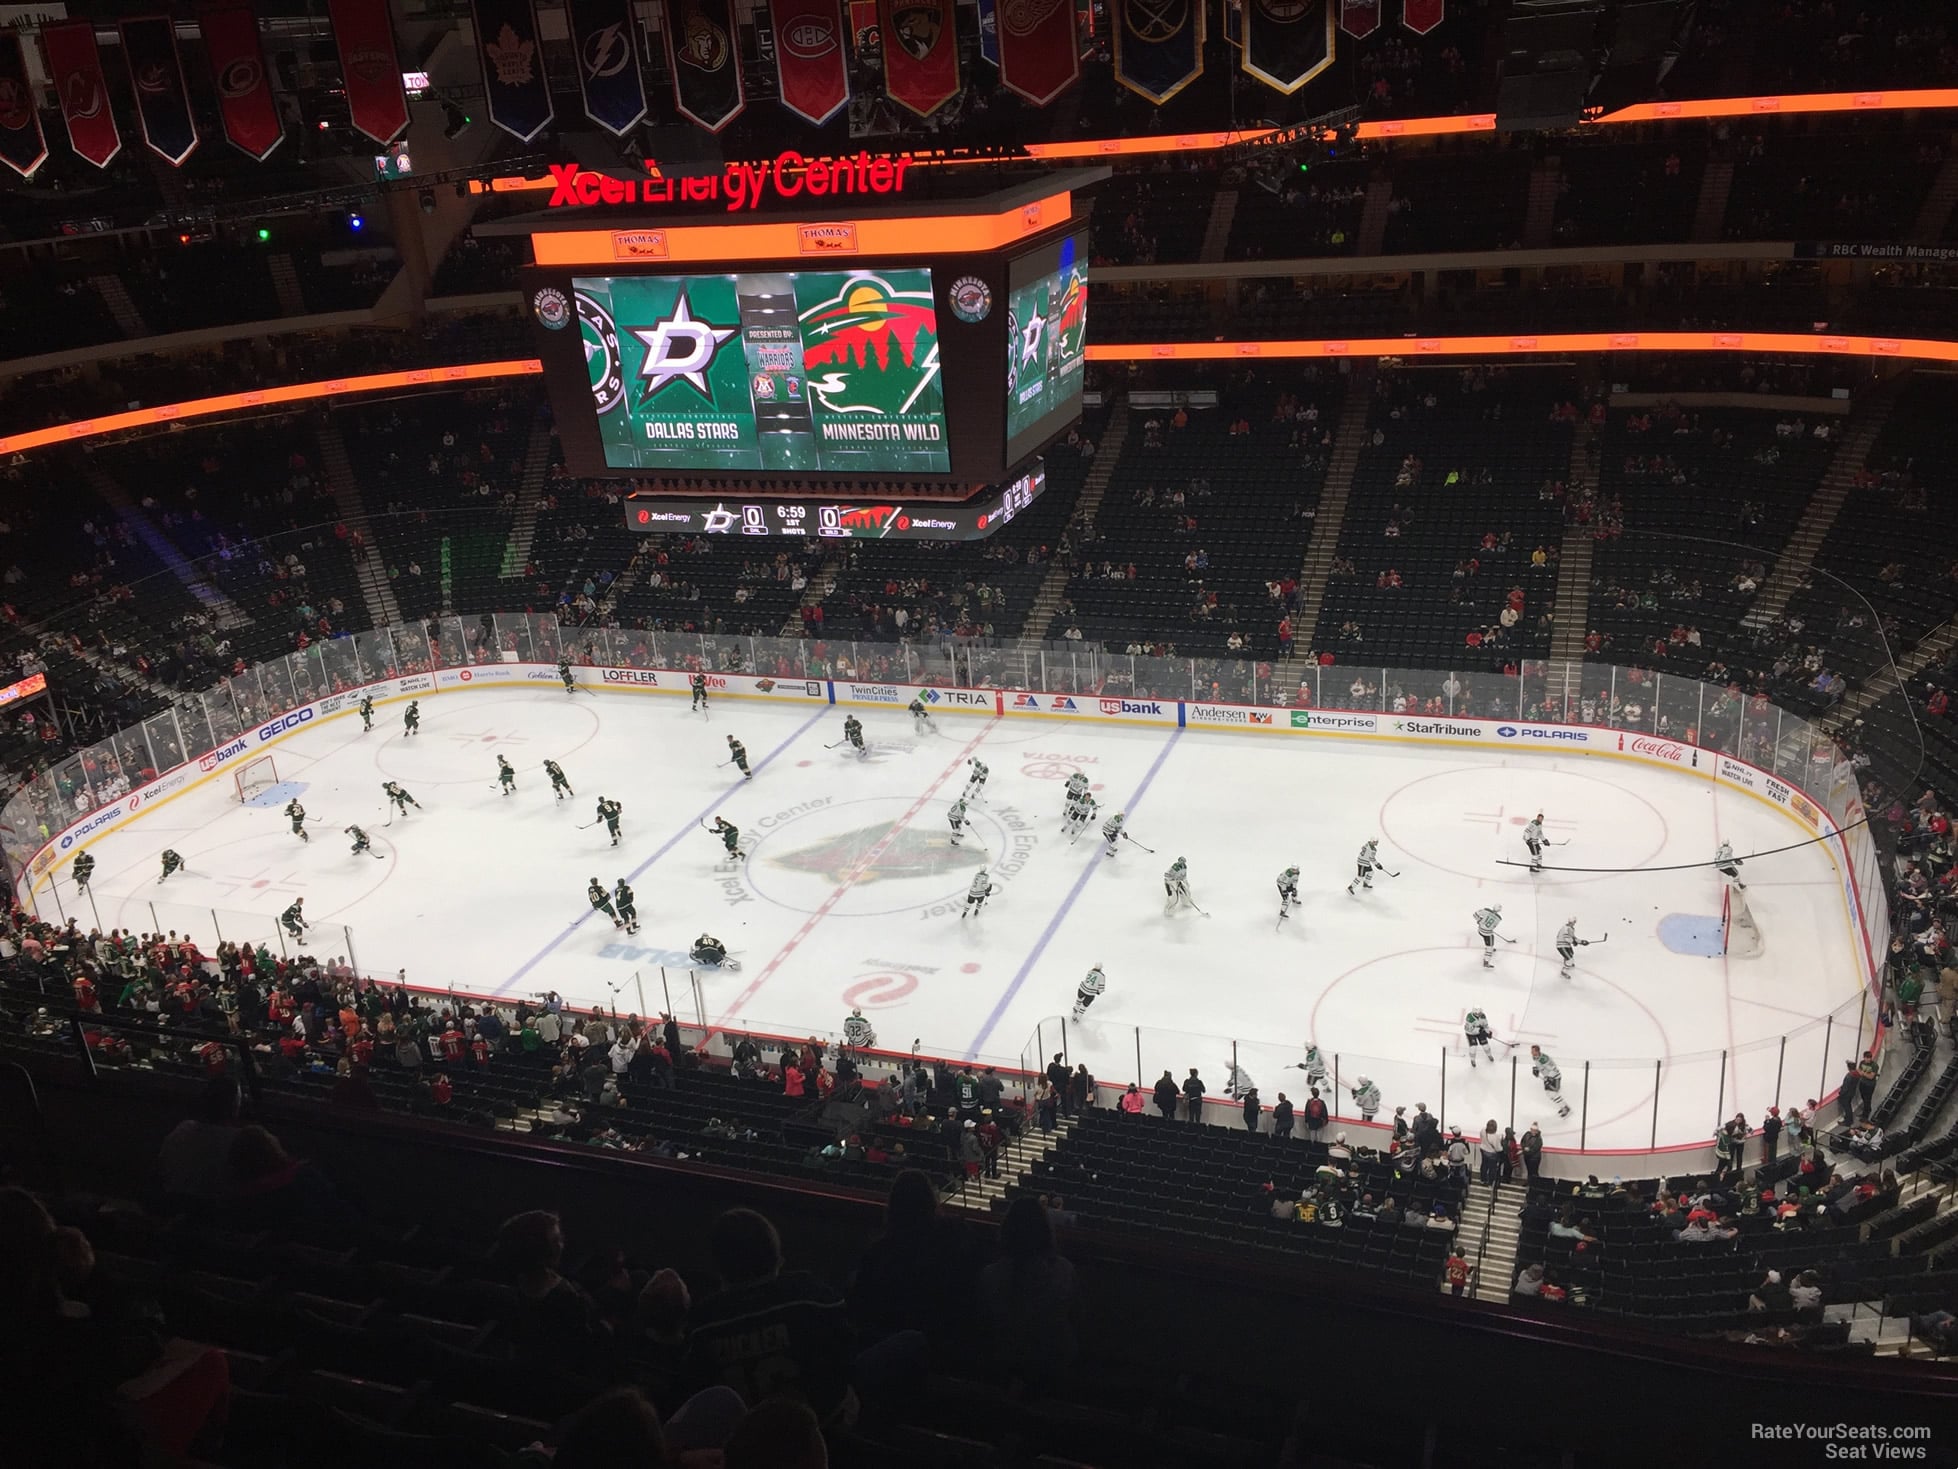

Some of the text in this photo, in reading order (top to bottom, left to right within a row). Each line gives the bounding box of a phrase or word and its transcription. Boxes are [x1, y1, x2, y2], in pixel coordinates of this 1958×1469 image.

[549, 163, 635, 207] Xcel
[774, 151, 912, 198] Center
[1832, 244, 1858, 255] RBC
[1861, 245, 1903, 256] Wealth
[950, 276, 990, 297] MINNESOTA
[749, 330, 783, 339] PRESENTED
[759, 351, 795, 369] WARRIORS
[645, 422, 739, 439] DALLAS STARS
[822, 423, 940, 440] MINNESOTA WILD
[746, 508, 760, 526] 0
[777, 506, 806, 518] 6:59
[824, 508, 836, 526] 0
[602, 669, 657, 683] LOFFLER
[944, 692, 988, 705] TRIA
[1192, 705, 1246, 719] Andersen
[258, 707, 314, 741] GEICO
[1298, 714, 1375, 728] enterprise
[1407, 721, 1481, 737] StarTribune
[1521, 728, 1589, 742] POLARIS
[1631, 737, 1684, 762] Coca-Cola
[1023, 751, 1099, 764] TOYOTA
[1765, 778, 1790, 796] FRESH
[1767, 790, 1787, 804] FAST
[74, 806, 121, 840] POLARIS
[991, 806, 1034, 831] Xcel
[714, 875, 755, 907] Xcel
[758, 796, 833, 829] Center
[993, 834, 1039, 881] Energy
[1485, 915, 1496, 929] 18
[702, 937, 714, 945] 40
[1086, 973, 1097, 986] 24
[850, 1025, 861, 1037] 32
[962, 1086, 972, 1098] 91
[1329, 1206, 1337, 1219] 9
[1451, 1267, 1464, 1279] 22
